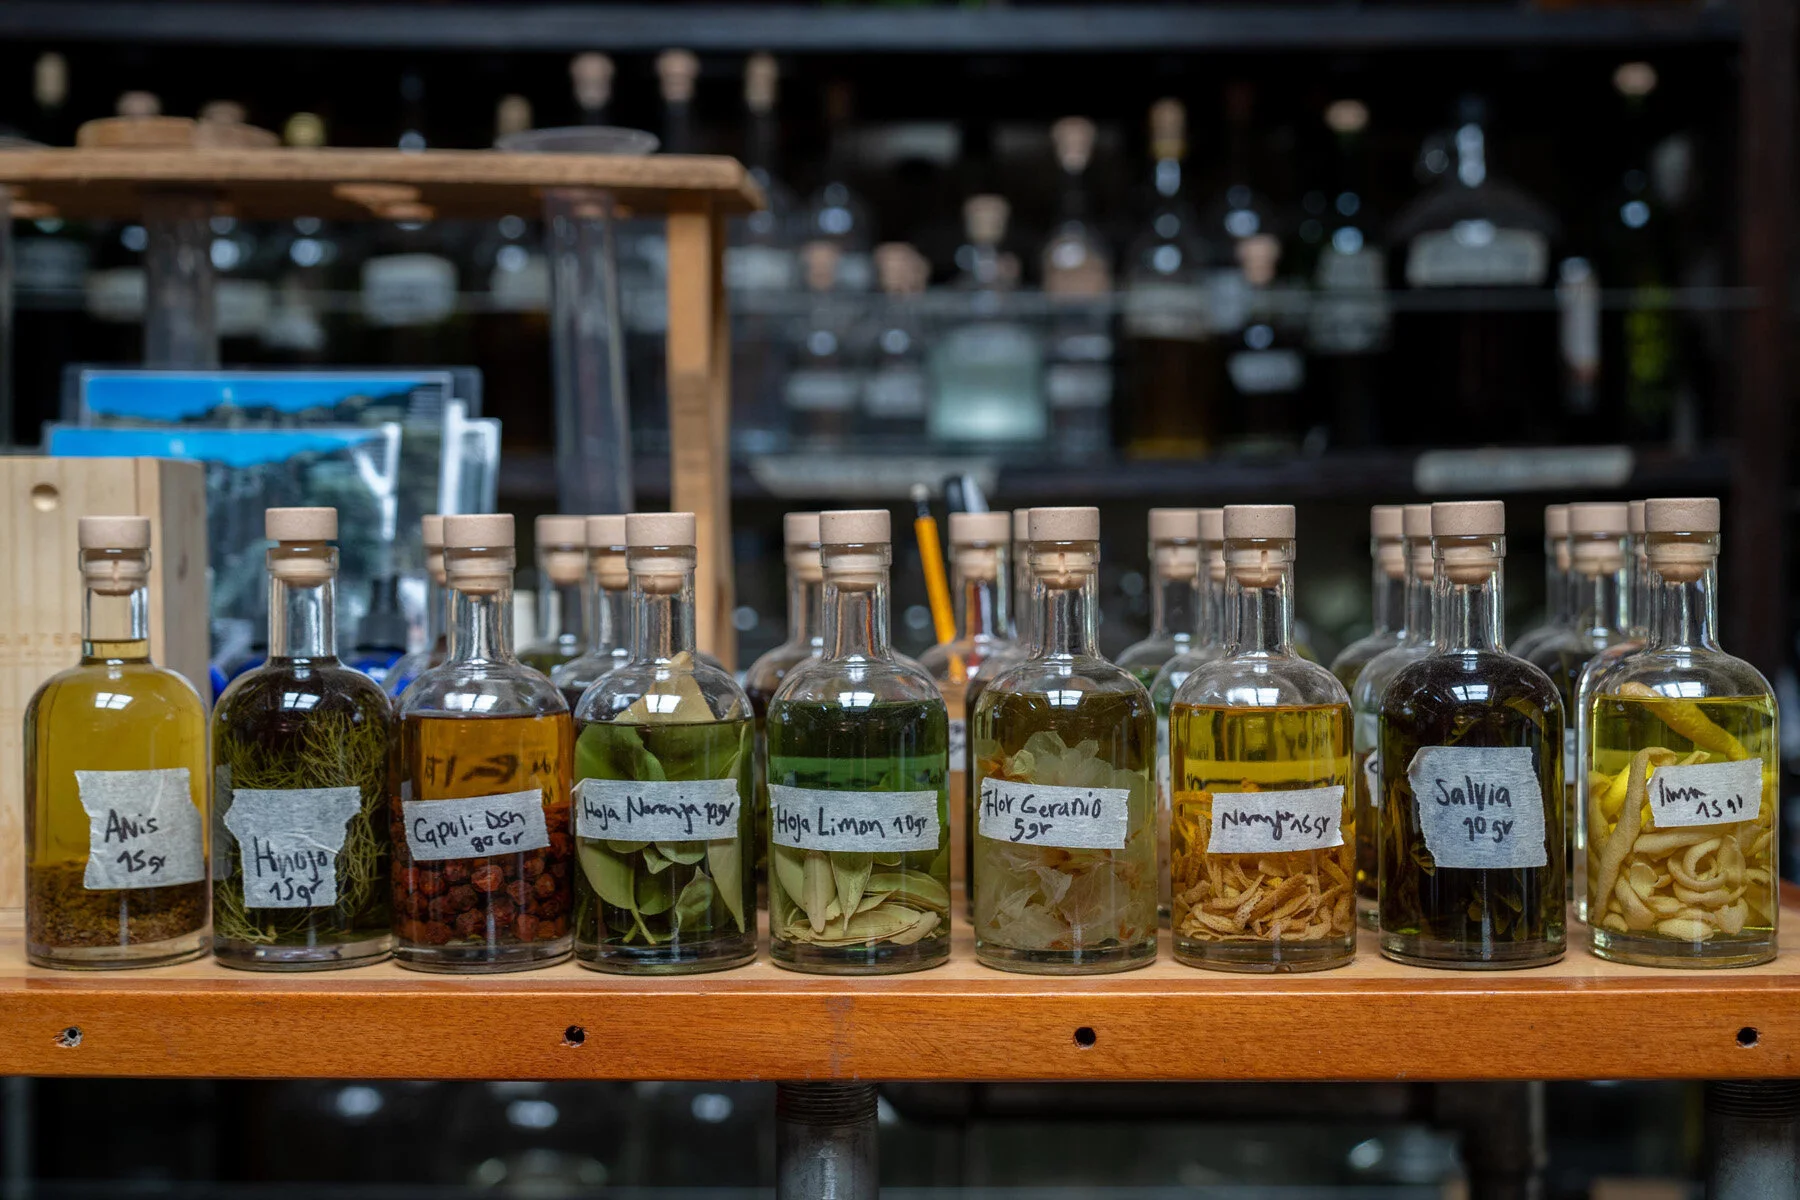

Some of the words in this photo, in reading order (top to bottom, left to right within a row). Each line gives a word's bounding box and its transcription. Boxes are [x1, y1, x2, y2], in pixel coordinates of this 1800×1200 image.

[982, 788, 1015, 816] Flor
[1020, 791, 1102, 819] Geranio
[1435, 775, 1512, 811] Salvia
[583, 796, 620, 831] Hoja
[626, 795, 701, 835] Naranja
[776, 804, 811, 843] Hoja
[818, 807, 886, 839] Limon
[253, 836, 328, 882] Hinojo
